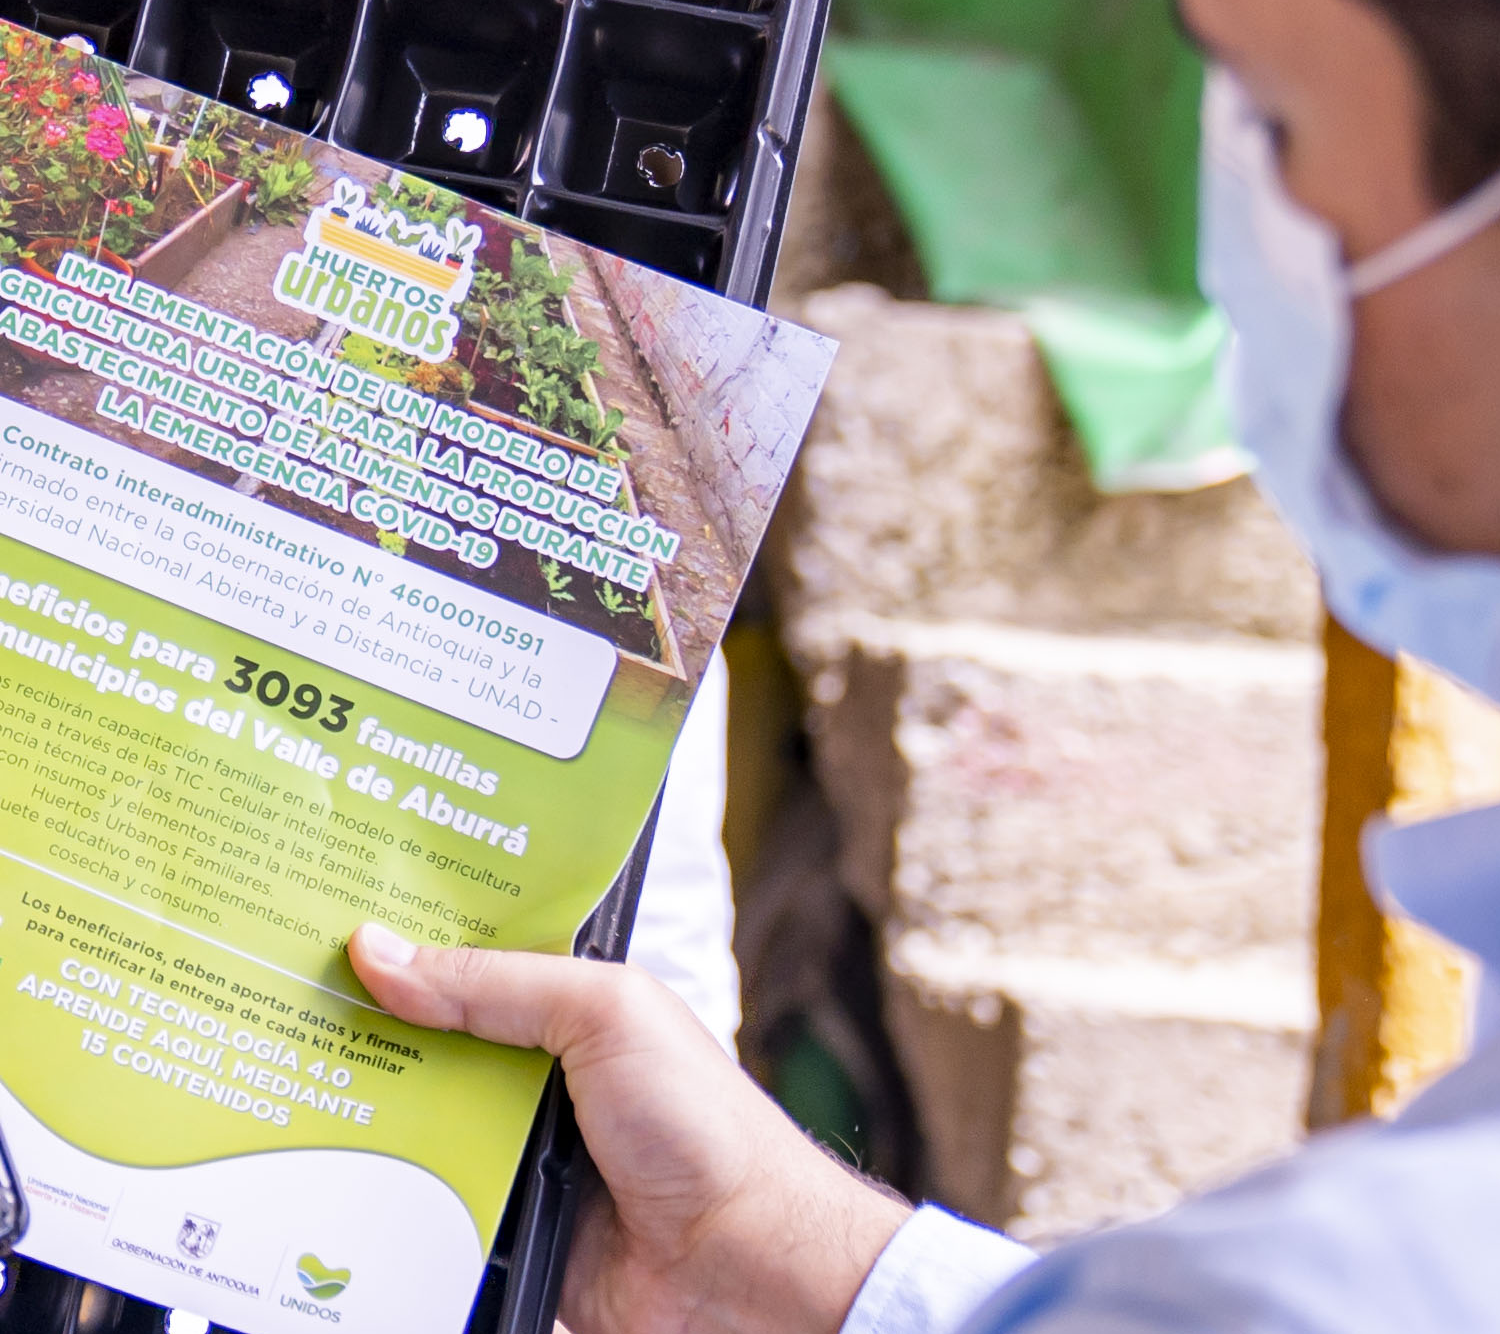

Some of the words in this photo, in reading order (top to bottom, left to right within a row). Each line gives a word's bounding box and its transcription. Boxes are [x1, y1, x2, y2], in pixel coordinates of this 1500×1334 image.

[283, 261, 448, 352] urbanos
[308, 246, 443, 315] HUERTOS
[59, 256, 333, 385] IMPLEMENTACIÓN
[335, 368, 381, 404] DE
[384, 387, 432, 424] UN
[434, 408, 567, 477] MODELO
[571, 462, 618, 498] DE
[196, 350, 324, 422] URBANA
[331, 406, 413, 459] PARA
[420, 441, 461, 477] LA
[467, 460, 676, 560] PRODUCCIÓN
[3, 425, 108, 480] Contrato
[115, 469, 344, 575] interadministrativo
[390, 583, 544, 656] 4600010591
[99, 390, 141, 425] LA
[147, 409, 345, 508] EMERGENCIA
[353, 493, 495, 565] COVID-19
[267, 419, 314, 454] DE
[315, 440, 495, 527] ALIMENTOS
[497, 510, 650, 588] DURANTE
[85, 495, 147, 530] entre
[154, 517, 174, 541] la
[183, 531, 333, 605] Gobernación
[341, 597, 370, 620] de
[376, 611, 493, 670] Antioquia
[498, 662, 516, 679] y
[521, 665, 541, 689] la
[87, 524, 192, 581] Nacional
[196, 570, 284, 619] Abierta
[289, 610, 307, 629] y
[312, 620, 326, 635] a
[334, 624, 442, 683] Distancia
[468, 677, 542, 720] UNAD
[15, 682, 92, 722] recibirán
[97, 716, 208, 768] capacitación
[214, 758, 279, 796] familiar
[282, 791, 304, 808] en
[308, 802, 325, 816] el
[328, 810, 394, 845] modelo
[399, 838, 421, 857] de
[426, 851, 520, 897] agricultura
[129, 630, 216, 683] para
[224, 655, 354, 732] 3093
[356, 716, 499, 796] familias
[183, 697, 246, 739] del
[253, 718, 340, 779] Valle
[346, 764, 394, 801] de
[397, 784, 529, 856] Aburrá
[31, 783, 100, 822] Huertos
[105, 813, 178, 856] Urbanos
[182, 846, 272, 897] Familiares.
[33, 760, 107, 800] insumos
[109, 793, 123, 808] y
[126, 801, 216, 847] elementos
[219, 841, 260, 865] para
[265, 855, 280, 874] la
[284, 864, 423, 934] implementación
[428, 927, 450, 945] de
[40, 718, 51, 730] a
[57, 721, 111, 753] través
[116, 746, 138, 764] de
[143, 754, 167, 775] las
[175, 766, 203, 790] TIC
[219, 787, 280, 822] Celular
[283, 812, 377, 865] inteligente.
[43, 740, 107, 776] técnica
[110, 770, 143, 789] por
[146, 780, 172, 803] los
[176, 796, 270, 844] municipios
[274, 838, 285, 851] a
[290, 841, 314, 863] las
[318, 853, 384, 892] familias
[44, 817, 130, 860] educativo
[135, 855, 156, 872] en
[160, 862, 175, 881] la
[180, 870, 322, 945] implementación,
[48, 844, 119, 882] cosecha
[122, 875, 136, 890] y
[140, 883, 221, 926] consumo.
[16, 974, 147, 1040] APRENDE
[149, 1029, 224, 1076] AQUÍ,
[231, 1058, 374, 1124] MEDIANTE
[21, 891, 51, 913] Los
[55, 905, 166, 965] beneficiarios,
[173, 957, 225, 987] deben
[230, 982, 294, 1015] aportar
[298, 1010, 349, 1037] datos
[350, 1030, 361, 1042] y
[366, 1032, 423, 1062] firmas,
[25, 919, 64, 942] para
[69, 937, 146, 975] certificar
[149, 967, 164, 984] la
[169, 979, 234, 1013] entrega
[239, 1008, 260, 1024] de
[266, 1020, 306, 1043] cada
[311, 1034, 334, 1053] kit
[339, 1044, 405, 1075] familiar
[60, 958, 122, 998] CON
[129, 984, 297, 1071] TECNOLOGÍA
[306, 1060, 350, 1088] 4.0
[81, 1029, 107, 1055] 15
[112, 1044, 290, 1125] CONTENIDOS
[187, 1264, 204, 1279] DE
[204, 1268, 261, 1300] ANTIOQUIA
[278, 1290, 343, 1328] UNIDOS
